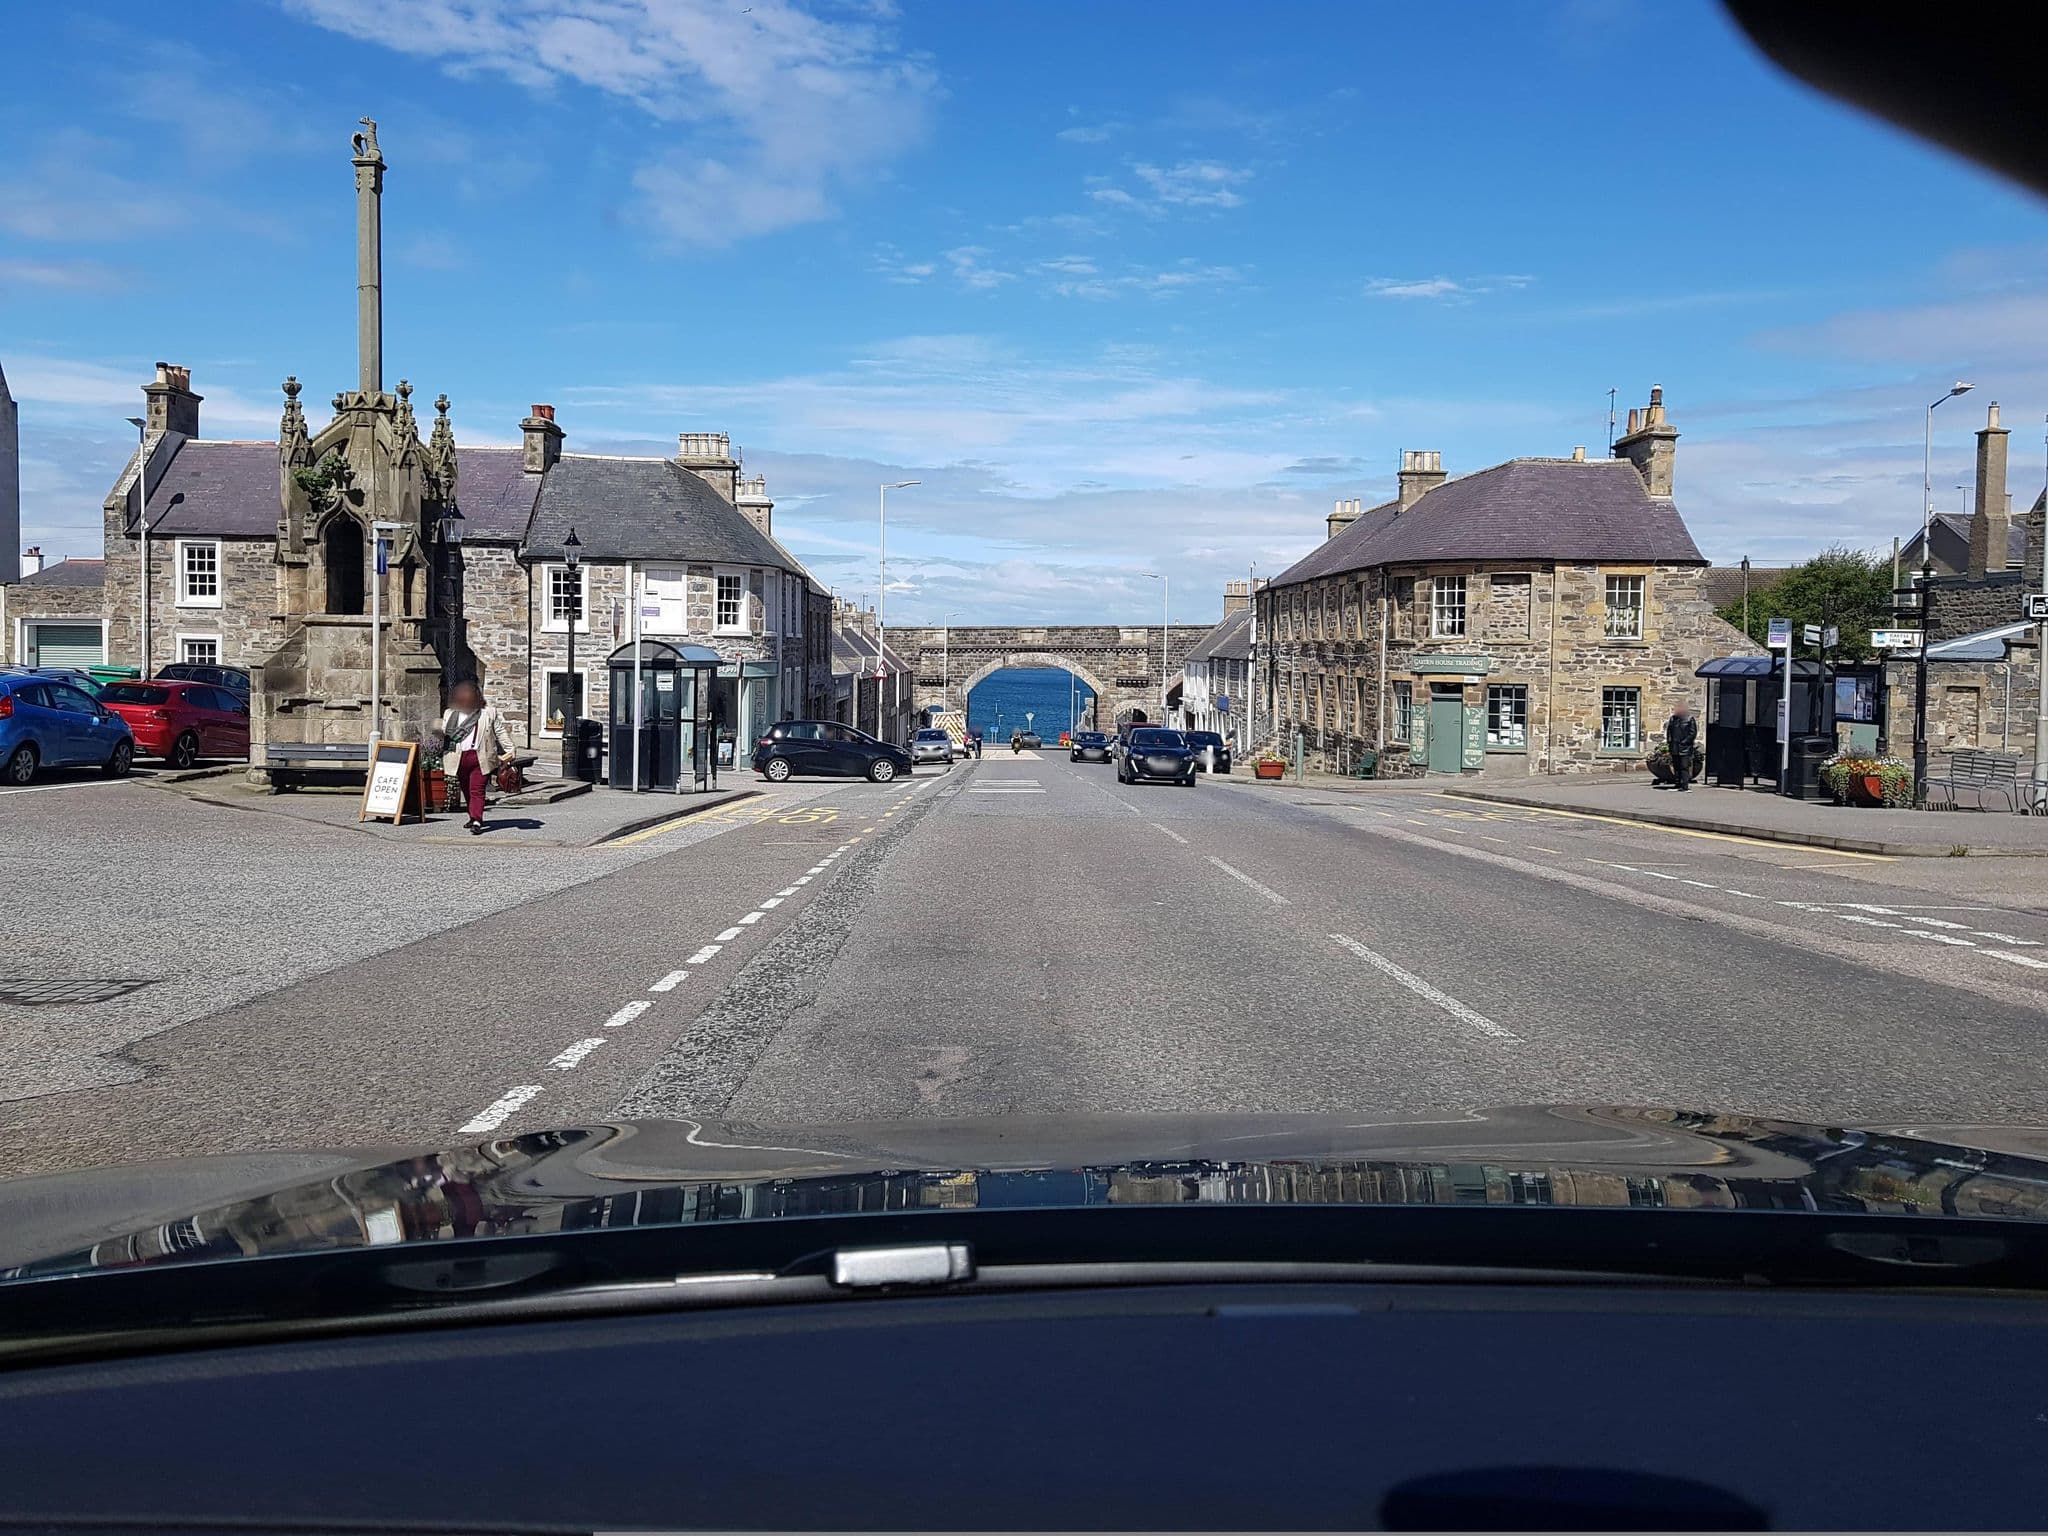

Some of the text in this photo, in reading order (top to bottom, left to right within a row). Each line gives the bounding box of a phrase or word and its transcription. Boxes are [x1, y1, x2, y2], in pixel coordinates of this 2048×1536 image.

[1456, 659, 1483, 667] TRADING
[377, 776, 399, 785] CAFE
[375, 785, 398, 793] OPEN
